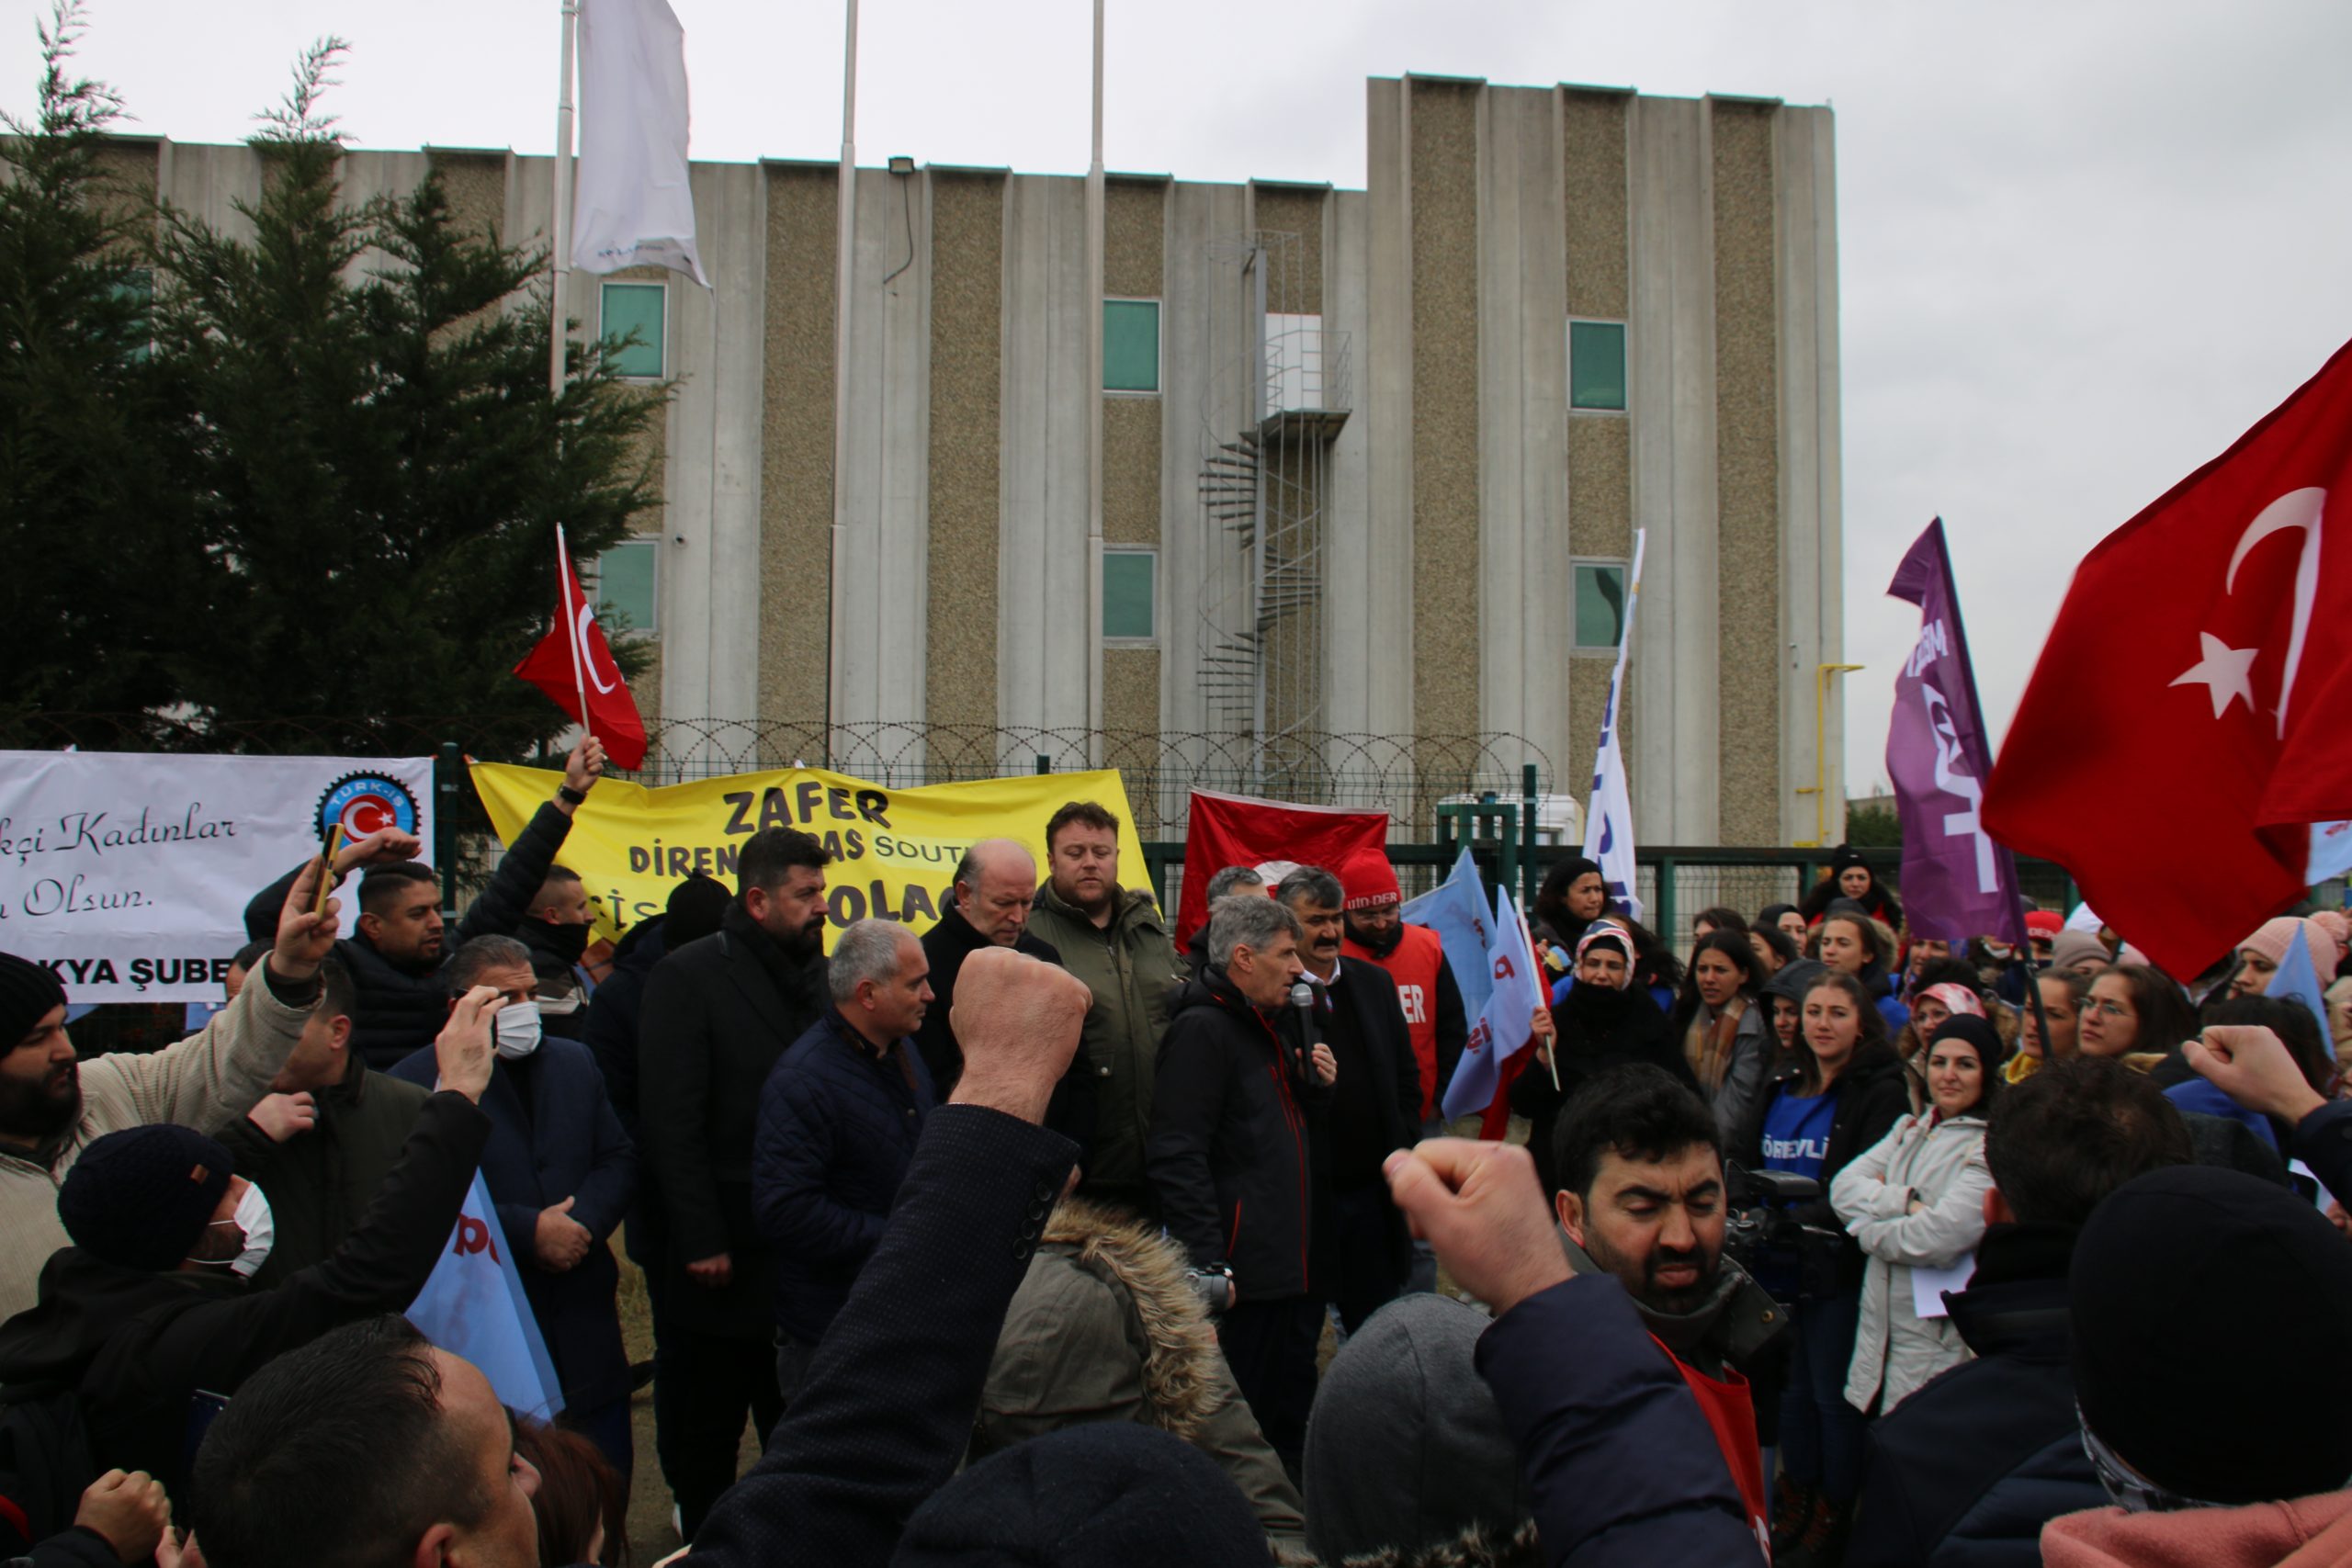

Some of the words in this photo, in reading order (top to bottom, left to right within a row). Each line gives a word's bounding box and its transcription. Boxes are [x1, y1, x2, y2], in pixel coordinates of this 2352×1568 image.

[53, 802, 236, 856] Kadınlar
[722, 781, 892, 836] ZAFER
[806, 829, 865, 863] AS
[875, 835, 970, 864] SOUT
[24, 874, 153, 917] Olsun.
